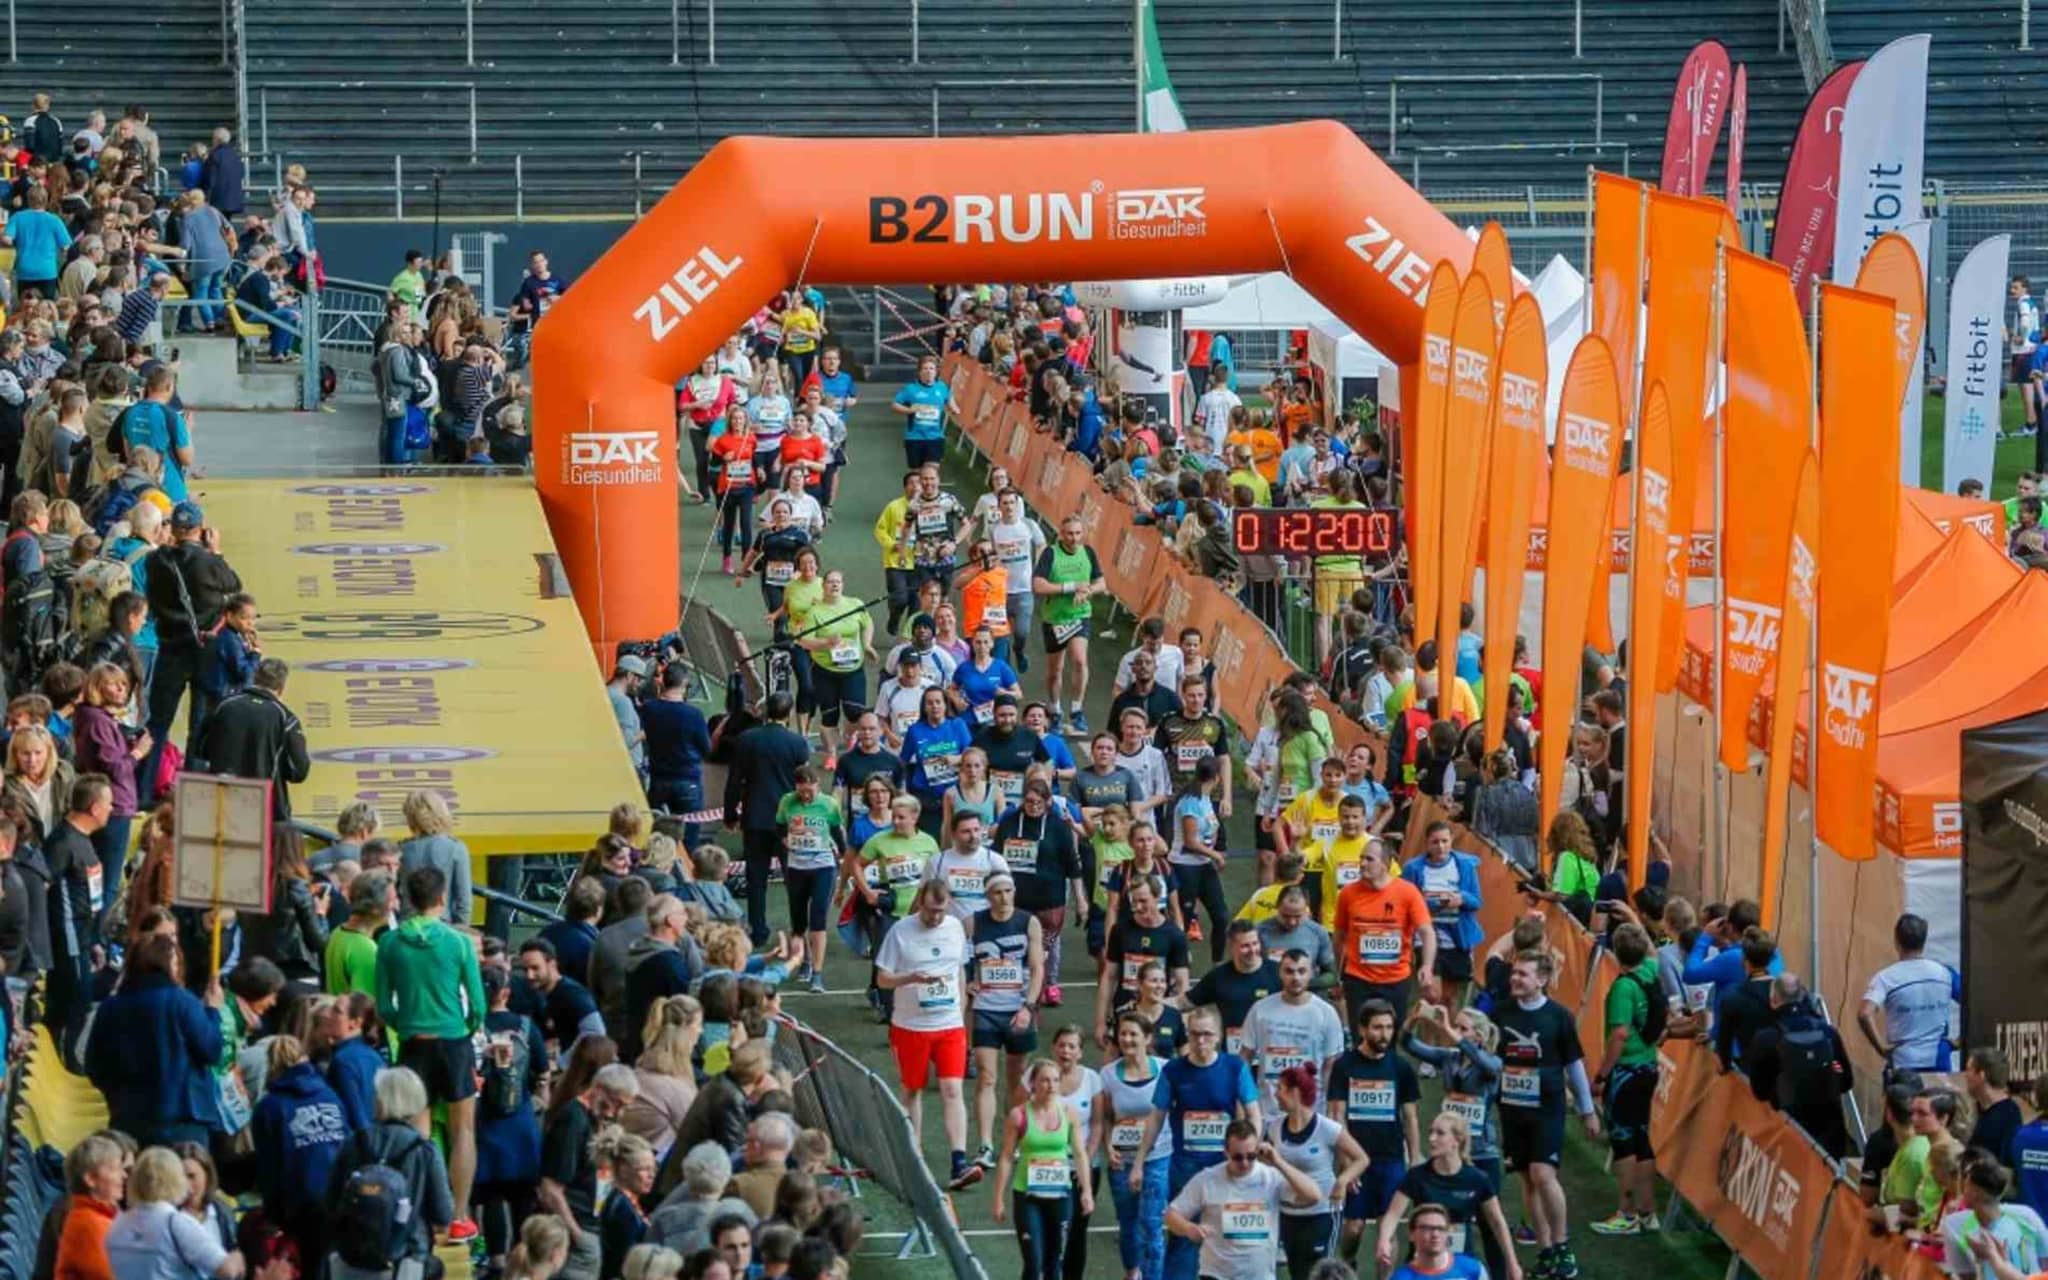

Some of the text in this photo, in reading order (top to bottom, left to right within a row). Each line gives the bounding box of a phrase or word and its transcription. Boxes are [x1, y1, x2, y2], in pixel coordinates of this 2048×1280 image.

[1702, 70, 1725, 136] THALYS
[1117, 187, 1206, 220] DAK
[1861, 163, 1902, 263] tbit
[1117, 220, 1206, 240] Gesundheit
[632, 245, 744, 343] ZIEL
[1174, 283, 1206, 296] fitbit
[1964, 316, 1991, 397] fitbit
[571, 431, 660, 464] DAK
[1565, 413, 1610, 454] DAK
[571, 464, 662, 486] Gesundheit
[1364, 938, 1399, 950] 10859
[1354, 1092, 1393, 1104] 10917
[1232, 1214, 1265, 1227] 1070
